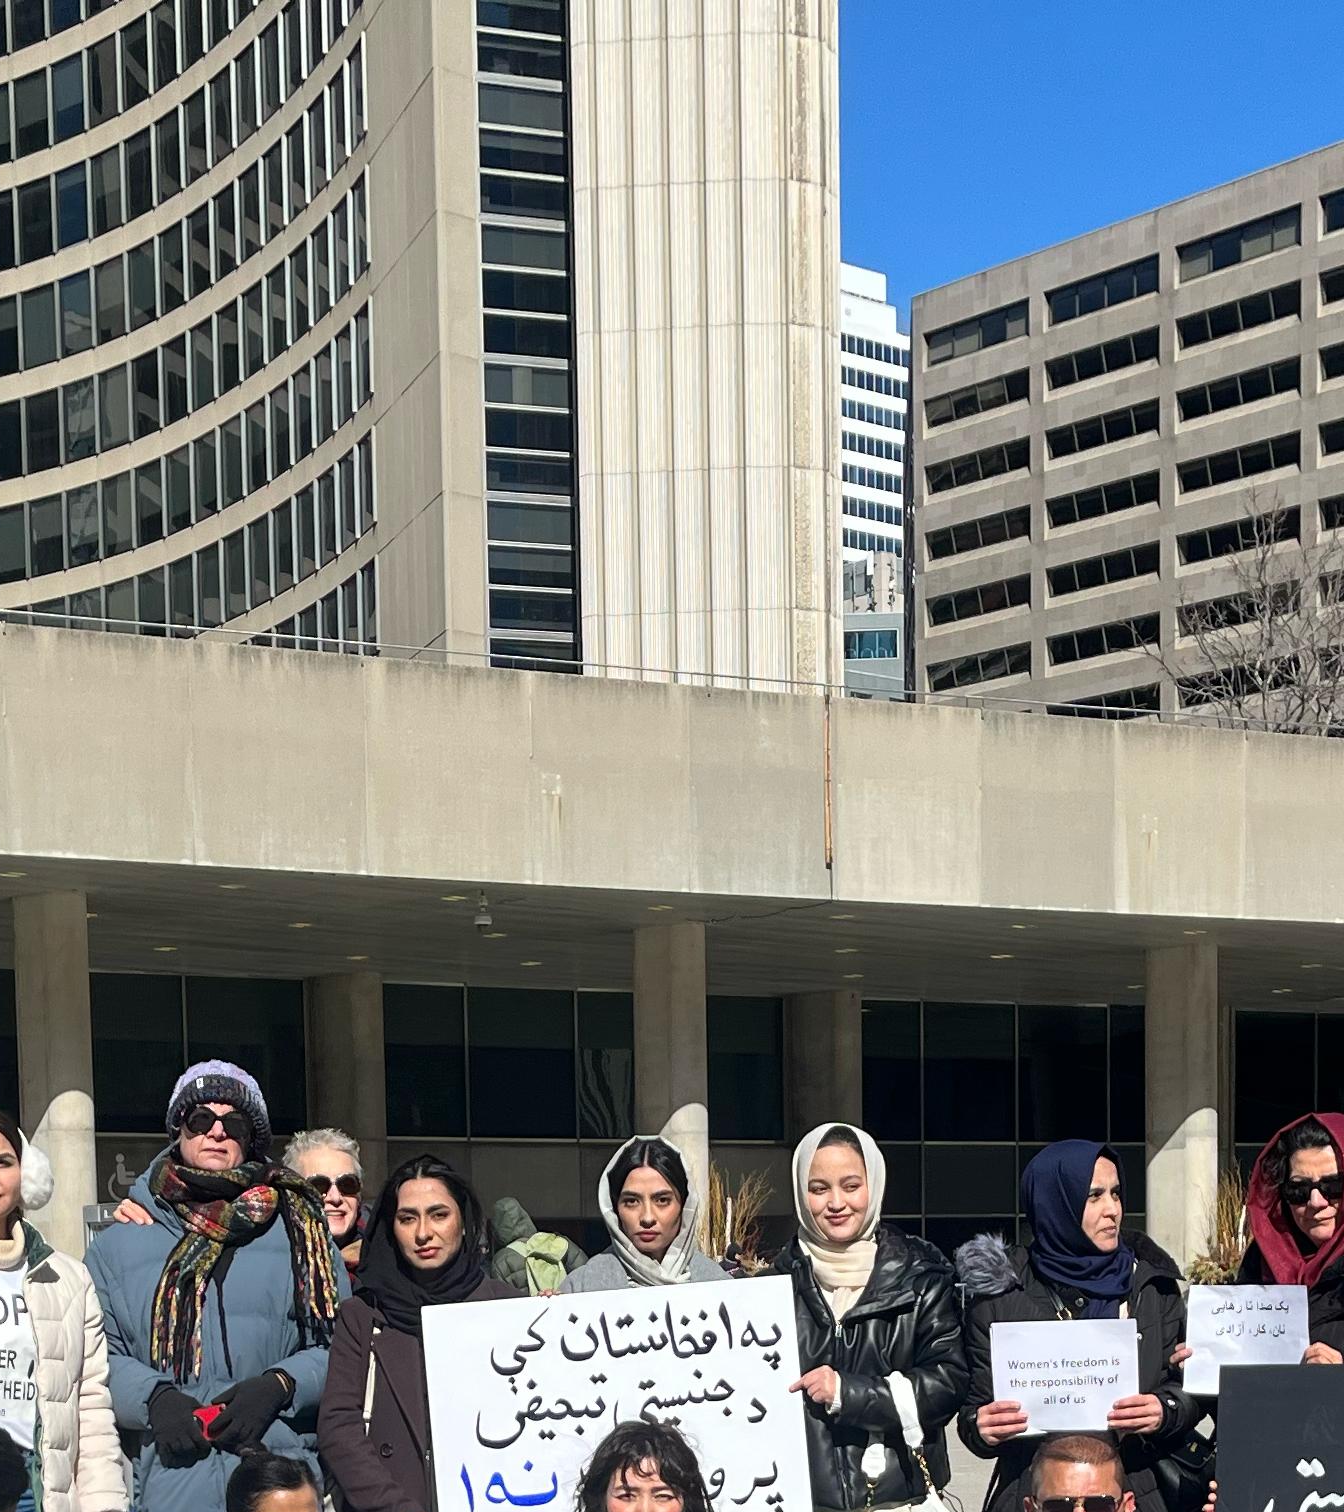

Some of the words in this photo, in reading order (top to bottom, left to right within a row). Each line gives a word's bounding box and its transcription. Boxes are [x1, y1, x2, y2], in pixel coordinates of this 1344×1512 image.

[559, 1301, 734, 1362] افغانستان
[1008, 1359, 1058, 1370] Women's
[1061, 1357, 1108, 1369] freedom
[1111, 1356, 1121, 1366] is
[1010, 1378, 1028, 1388] the
[1031, 1375, 1104, 1389] responsibility
[1107, 1373, 1119, 1384] of
[1043, 1395, 1056, 1405] all
[1059, 1394, 1070, 1404] of
[1074, 1396, 1086, 1404] us
[747, 1397, 768, 1423] د
